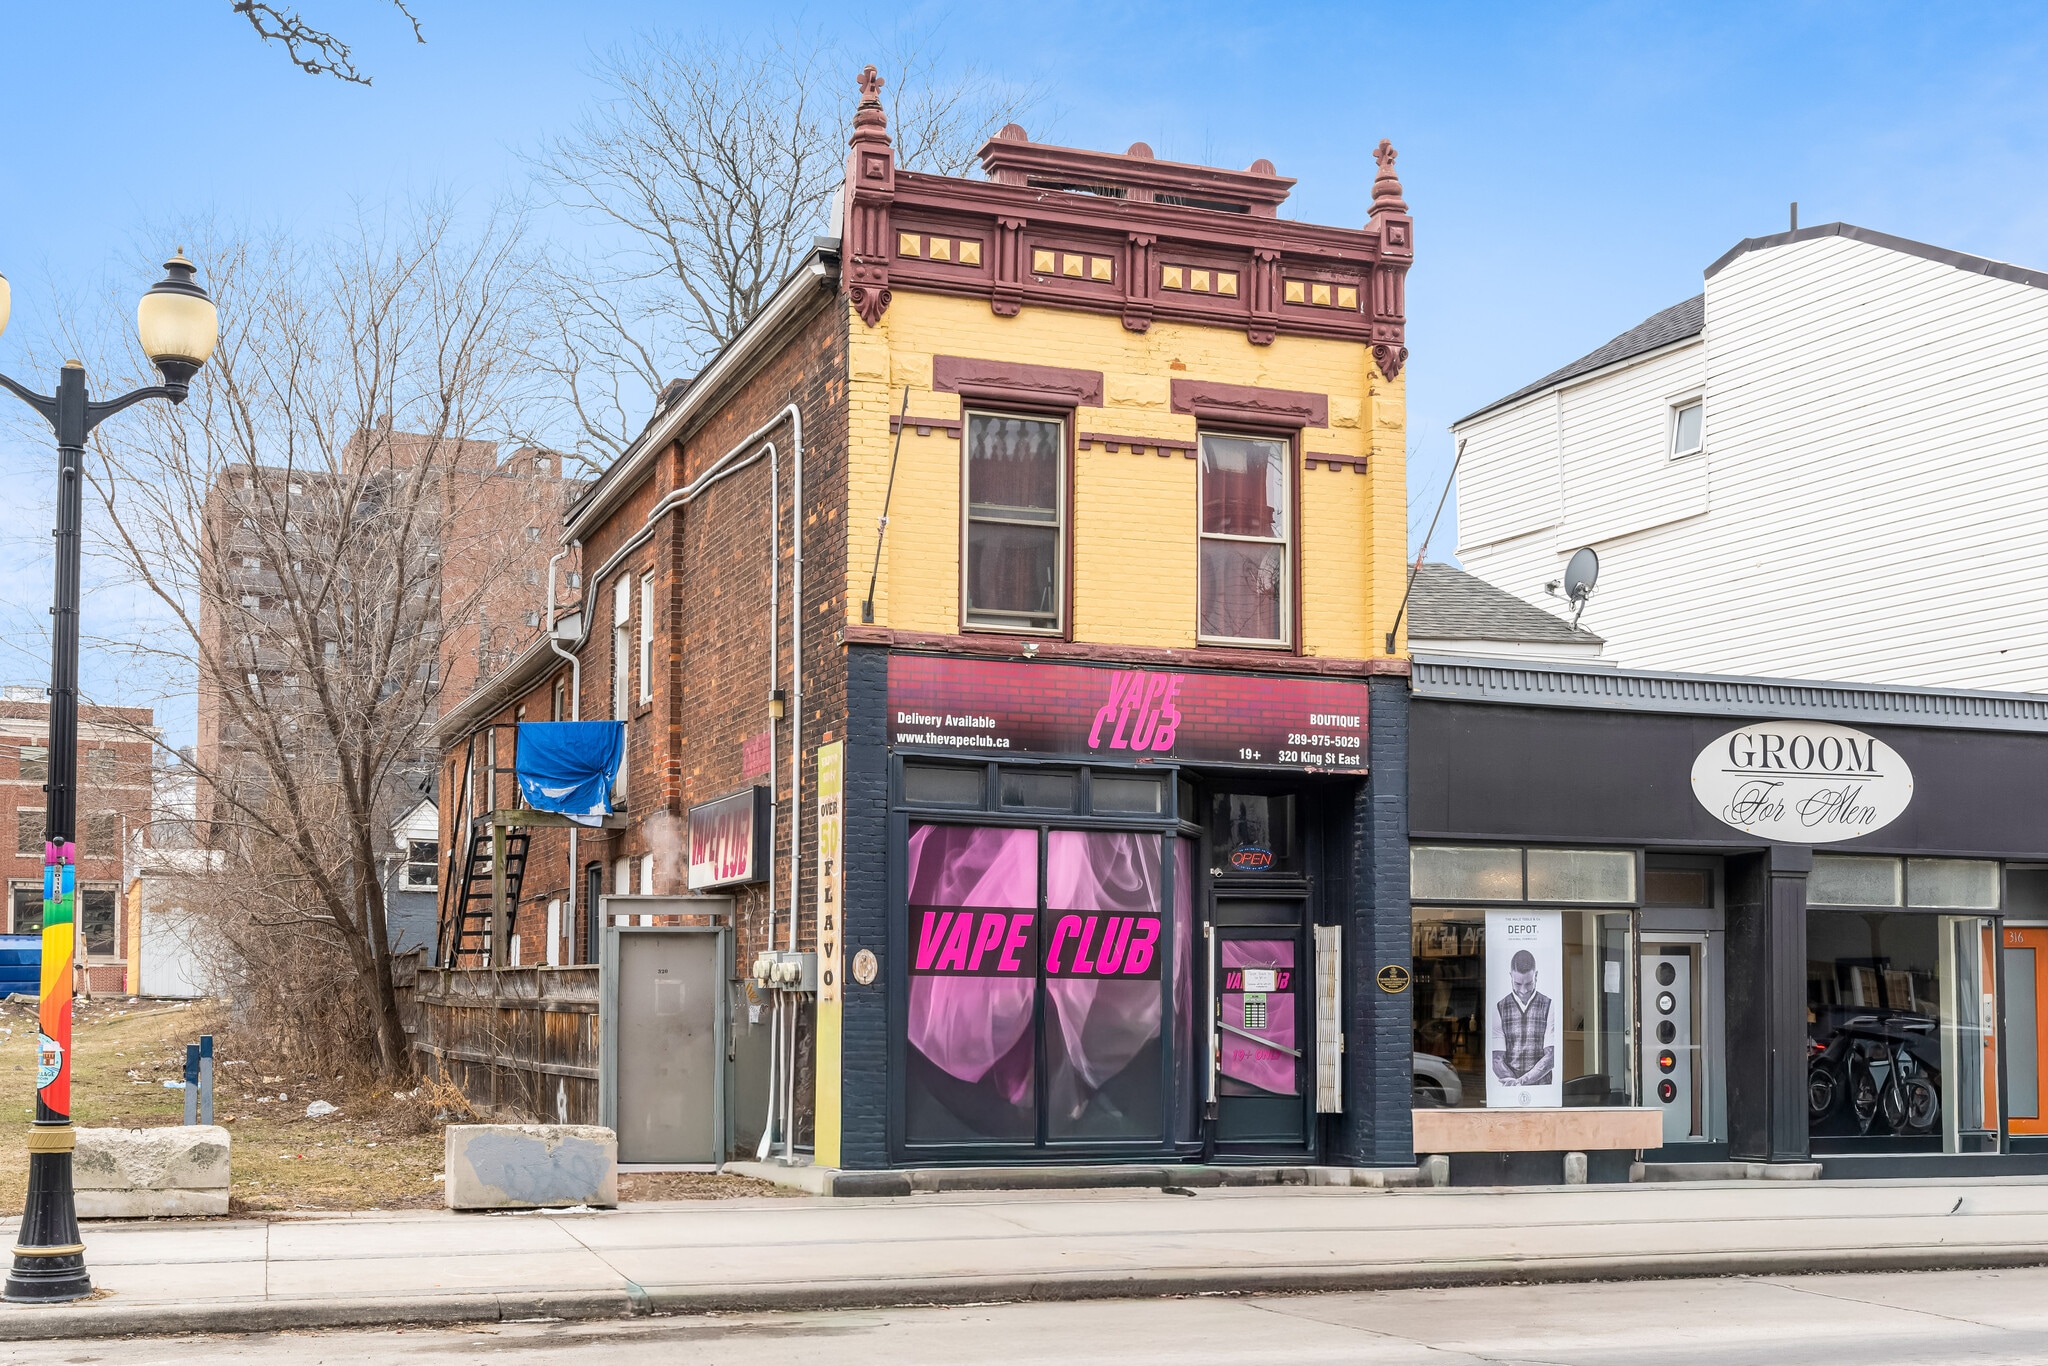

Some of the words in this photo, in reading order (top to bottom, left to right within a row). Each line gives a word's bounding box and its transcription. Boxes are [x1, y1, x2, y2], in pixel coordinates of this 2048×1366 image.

[1108, 671, 1185, 711] VAPE
[897, 711, 942, 728] Delivery
[945, 714, 996, 728] Available
[1310, 713, 1360, 727] BOUTIQUE
[1087, 705, 1182, 751] CLUB
[896, 732, 1010, 748] www.thevapeclub.ca
[1287, 733, 1360, 748] 289-975-5029
[1239, 748, 1261, 760] 19+
[1278, 750, 1298, 762] 320
[1300, 751, 1322, 765] King
[1325, 752, 1336, 764] St
[1338, 753, 1360, 765] East
[1728, 732, 1878, 772] GROOM
[820, 801, 838, 817] OVER
[1722, 780, 1786, 826] For
[1795, 784, 1877, 827] Men
[714, 808, 750, 880] CLUB
[820, 821, 838, 854] 50
[1231, 852, 1273, 865] OPEN
[823, 860, 834, 1001] FLAVO
[1507, 924, 1538, 934] DEPOT
[2009, 931, 2024, 943] 316
[915, 911, 1034, 971] VAPE
[1045, 914, 1161, 975] CLUB
